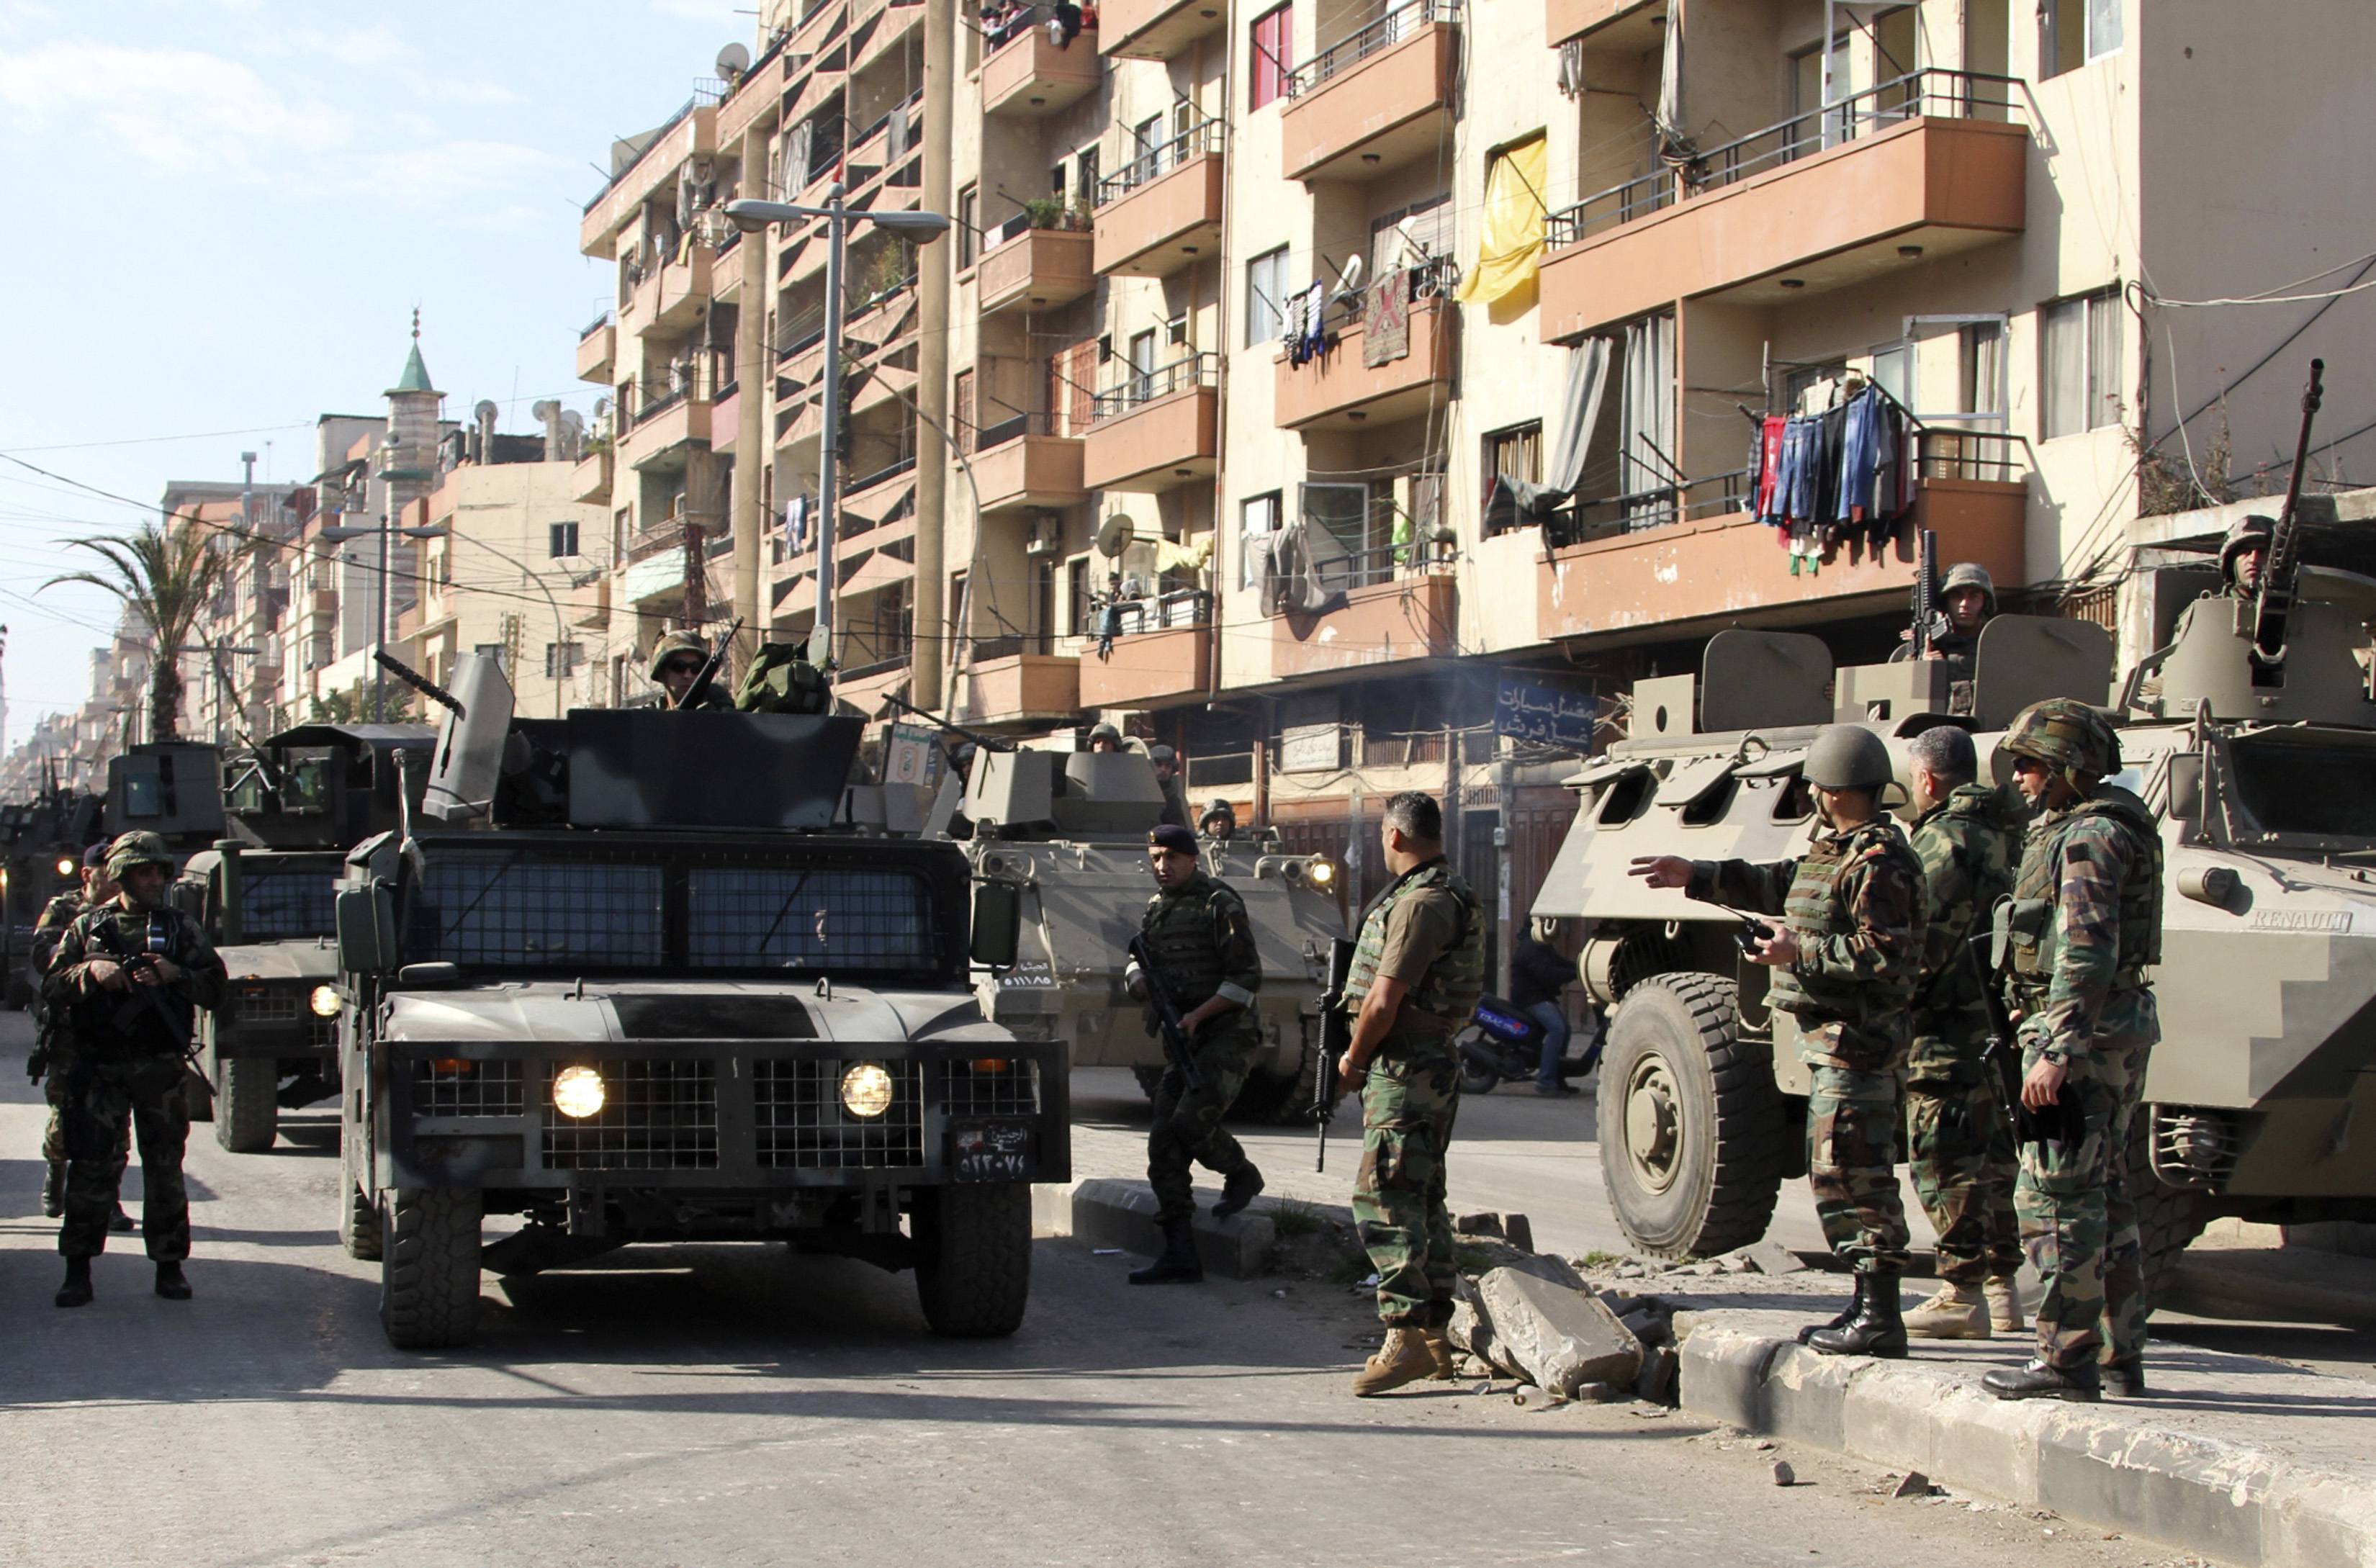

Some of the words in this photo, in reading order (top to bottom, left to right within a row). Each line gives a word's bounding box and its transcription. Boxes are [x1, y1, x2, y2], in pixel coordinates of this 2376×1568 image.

[1498, 687, 1554, 714] سيارات
[1551, 695, 1594, 720] مغسل
[1498, 714, 1546, 739] فرش
[1544, 721, 1588, 744] غسيل
[2254, 910, 2349, 930] RENAULT
[1004, 976, 1051, 986] ٥١١١٨٥
